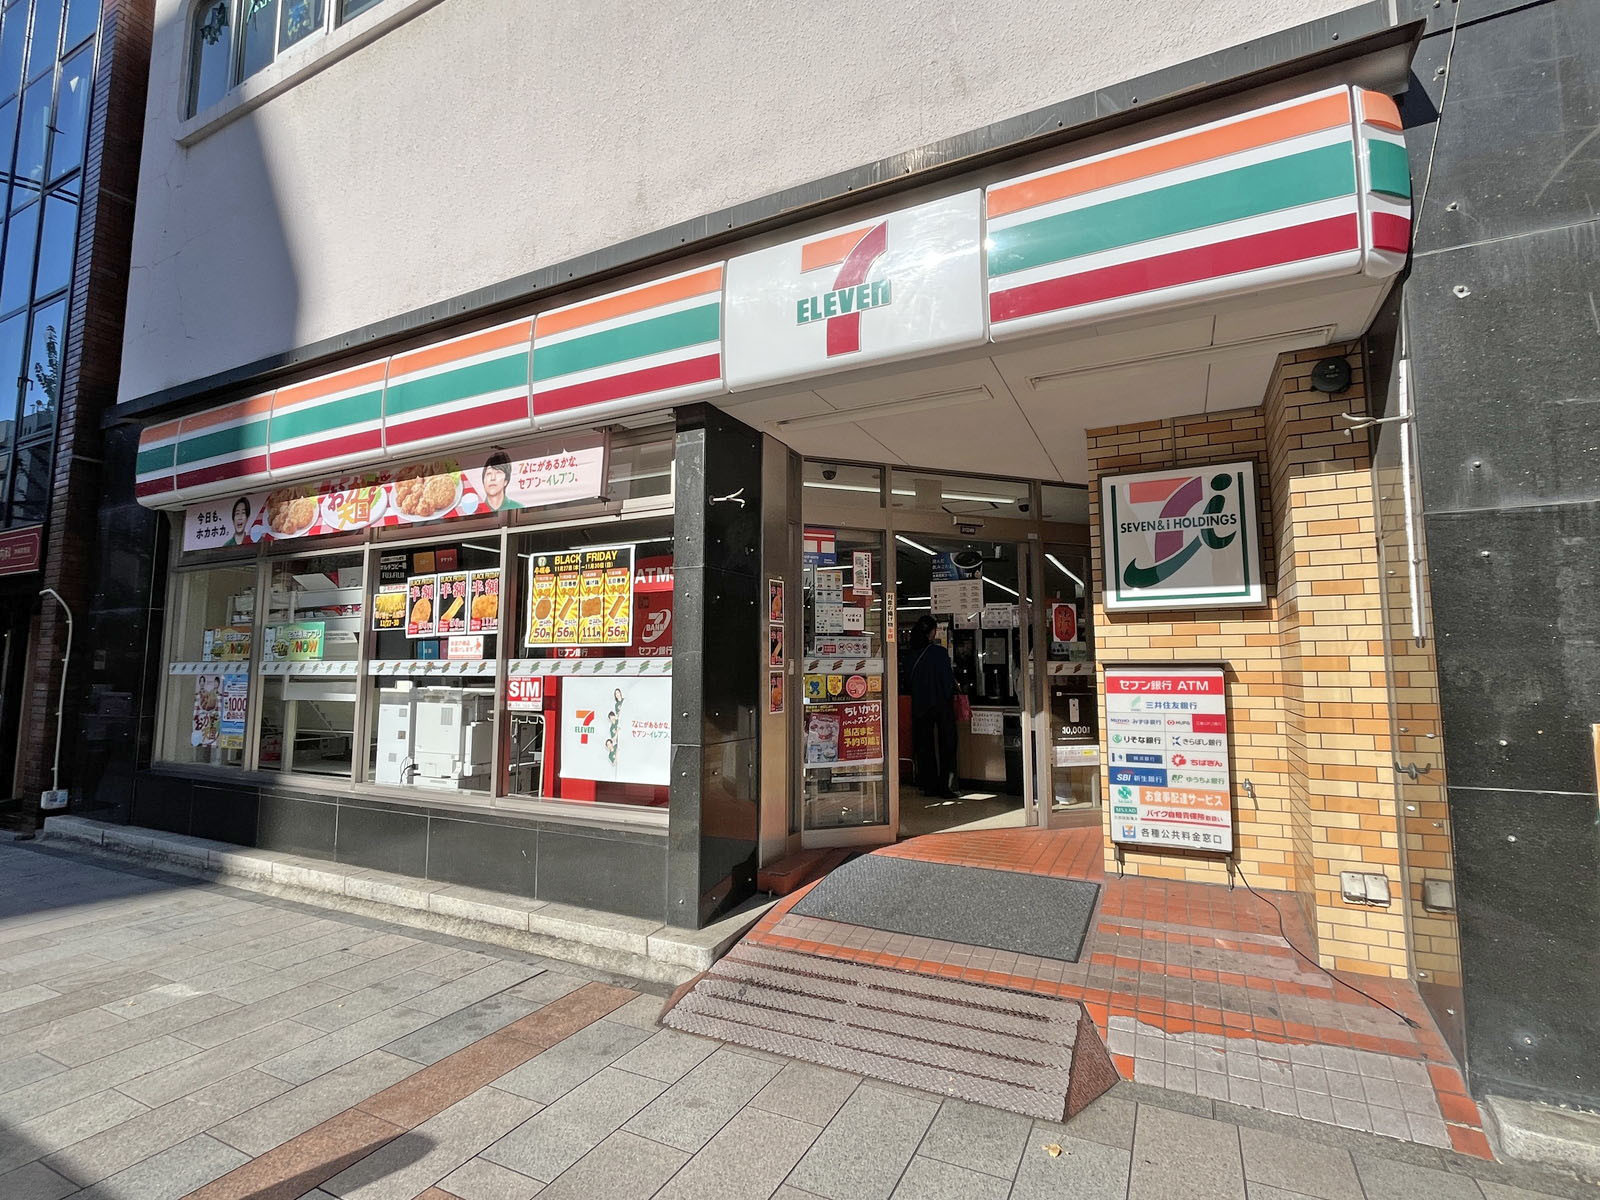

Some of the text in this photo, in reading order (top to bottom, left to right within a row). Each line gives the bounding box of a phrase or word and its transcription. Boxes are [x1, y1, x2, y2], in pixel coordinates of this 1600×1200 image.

[197, 511, 222, 525] 今日も、
[1173, 513, 1237, 529] HOLDINGS
[554, 550, 618, 565] BLACK FRIDAY
[533, 627, 551, 638] 50円
[557, 627, 574, 637] 56円
[582, 626, 600, 638] 111円
[607, 626, 625, 637] 56円
[508, 681, 540, 697] SIM
[1120, 680, 1209, 691] セブン銀行 ATM
[844, 703, 880, 717] ちいかわ
[1145, 701, 1198, 710] 三井住友銀行
[1123, 736, 1161, 745] りそな銀行
[1182, 738, 1222, 747] きらぼし銀行
[1190, 759, 1223, 768] ちばぎん
[1116, 773, 1163, 784] SBI 新生銀行
[1186, 776, 1225, 785] ゆうちょ銀行
[1144, 790, 1223, 807] お食事配達サービス
[1141, 828, 1223, 845] 各種公共料金窓口
